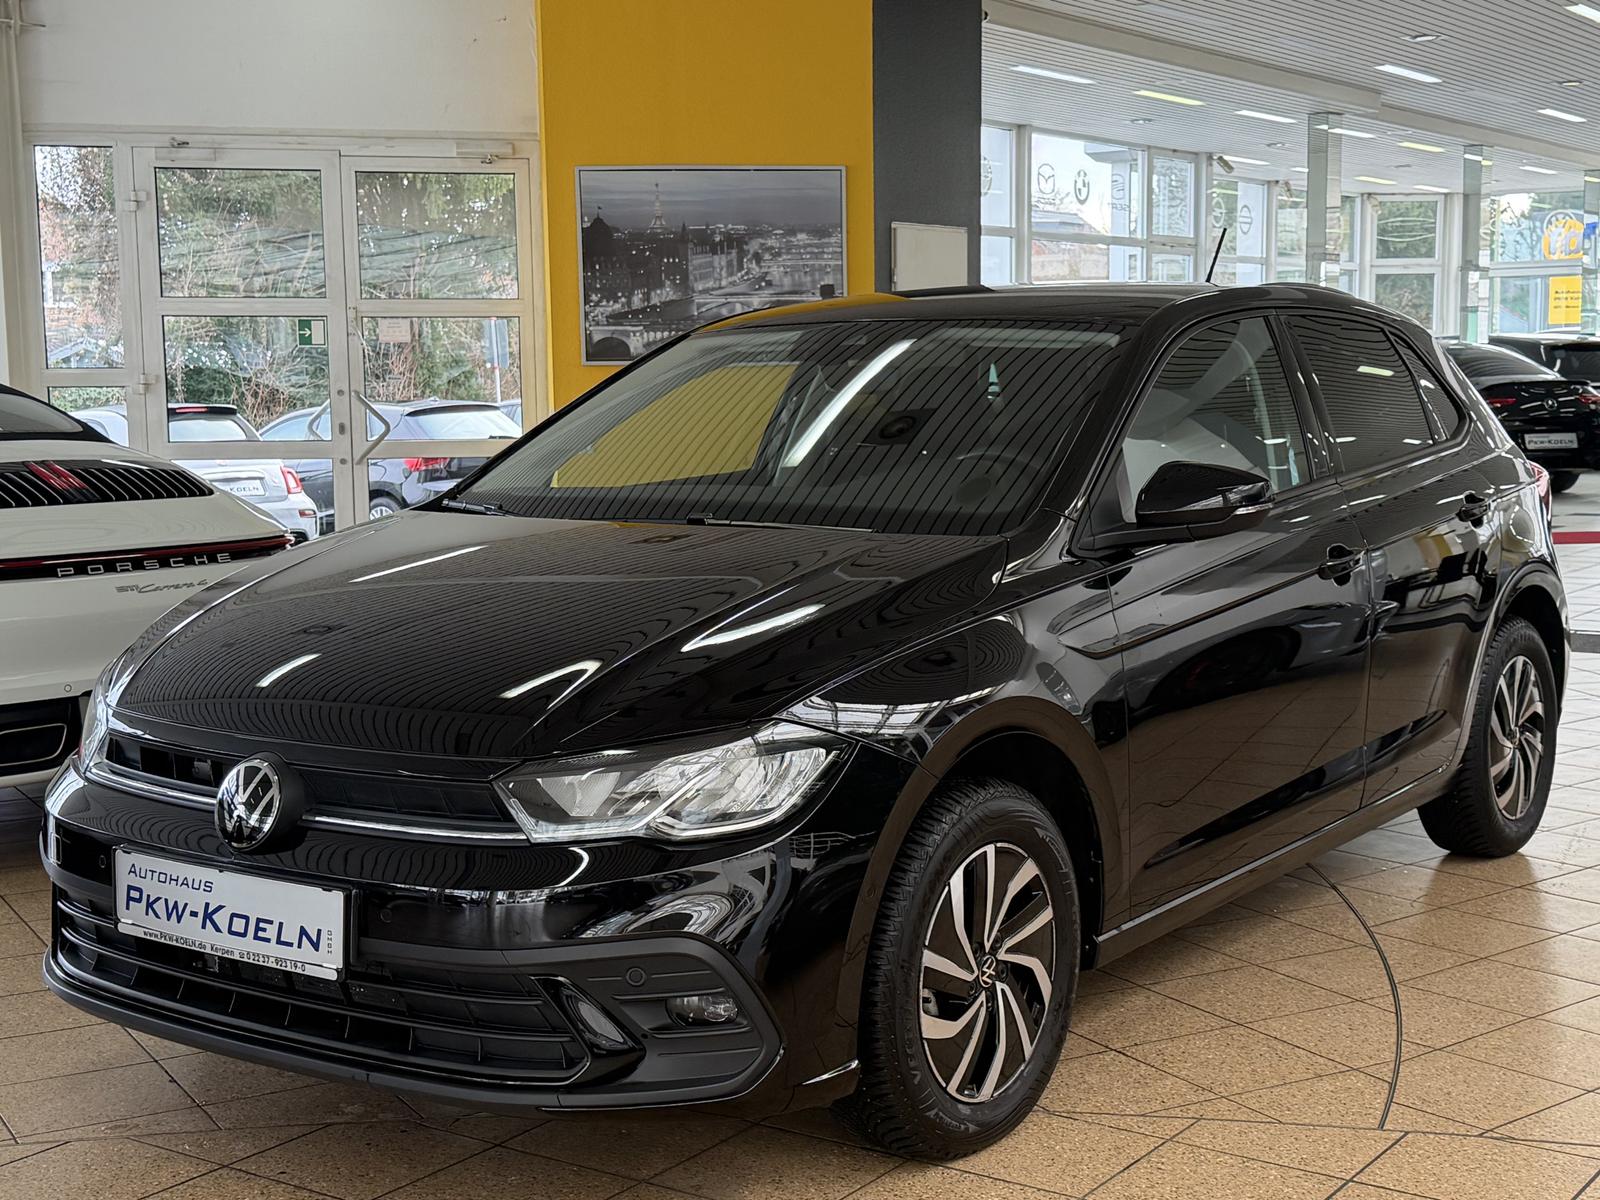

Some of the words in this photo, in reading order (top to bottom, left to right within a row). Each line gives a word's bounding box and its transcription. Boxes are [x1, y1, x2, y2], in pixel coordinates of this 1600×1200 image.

[57, 553, 232, 577] PORSCHE
[127, 863, 214, 893] AUTOHAUS
[125, 884, 322, 952] PKW-KOELN
[142, 930, 207, 951] www.PKW-KOELN.de
[210, 943, 235, 959] Kerpen
